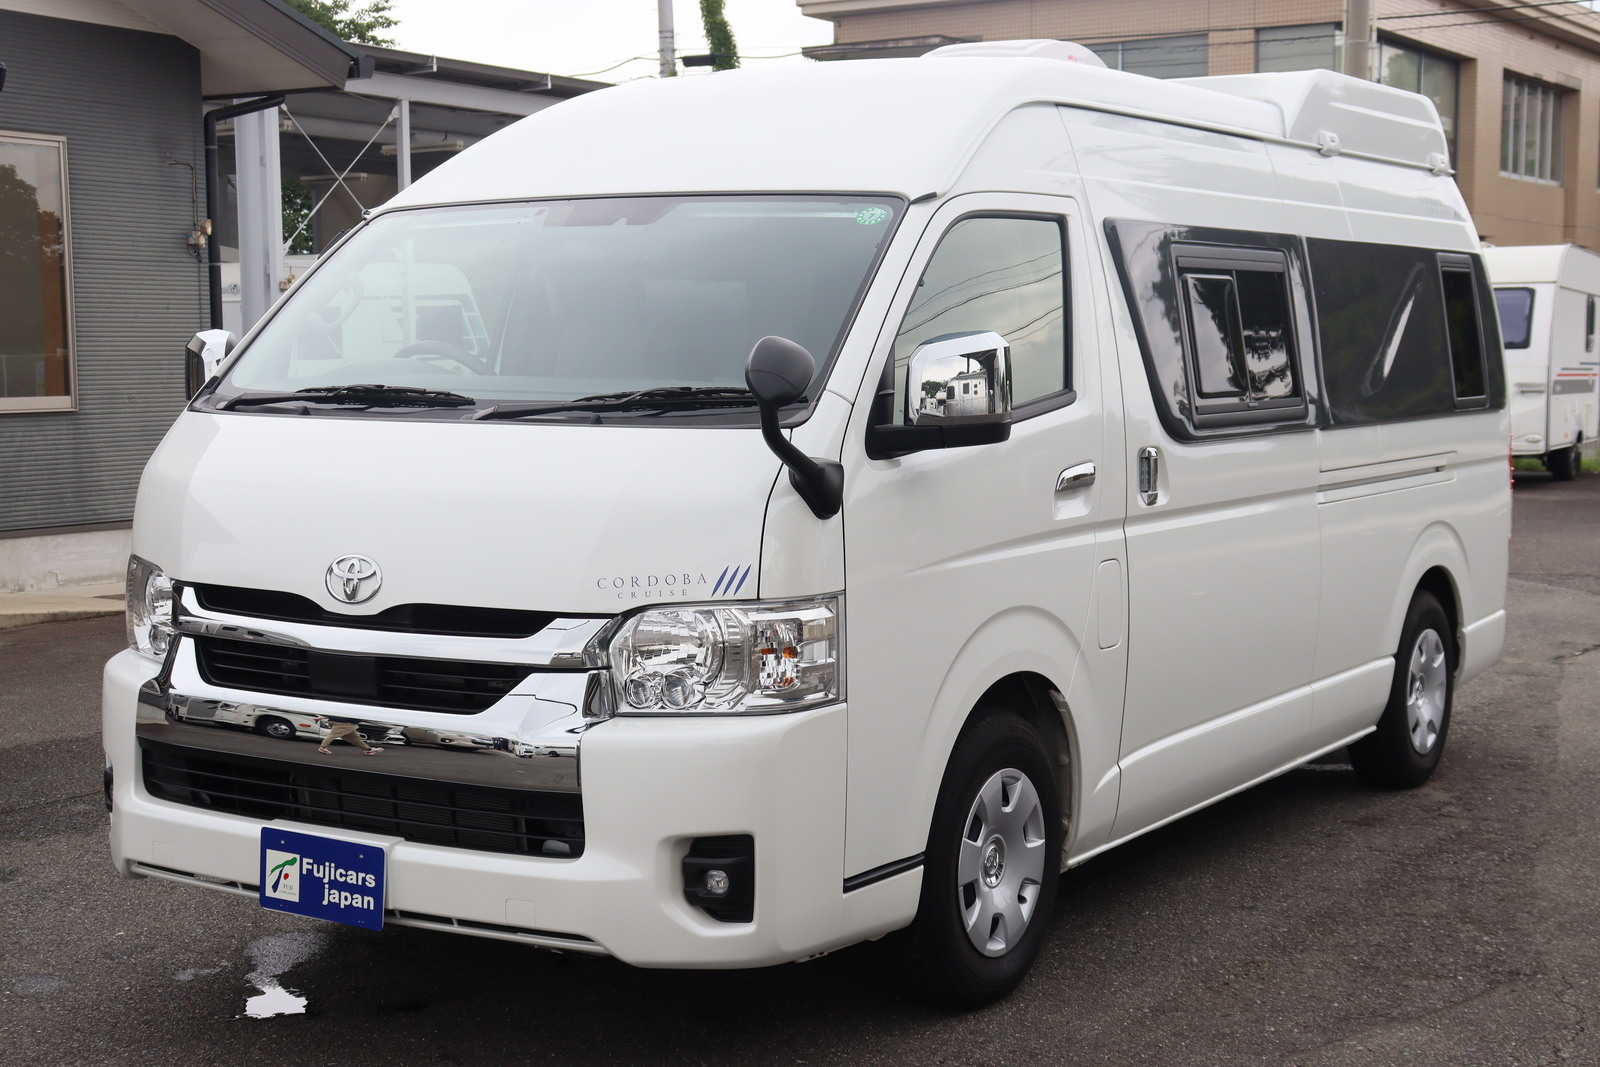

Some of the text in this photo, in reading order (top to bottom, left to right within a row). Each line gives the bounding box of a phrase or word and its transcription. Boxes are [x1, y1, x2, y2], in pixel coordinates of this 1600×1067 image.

[597, 573, 707, 589] CORDOBA
[618, 589, 688, 599] CRUISE
[302, 857, 376, 887] Fujicars
[322, 884, 374, 910] japan
